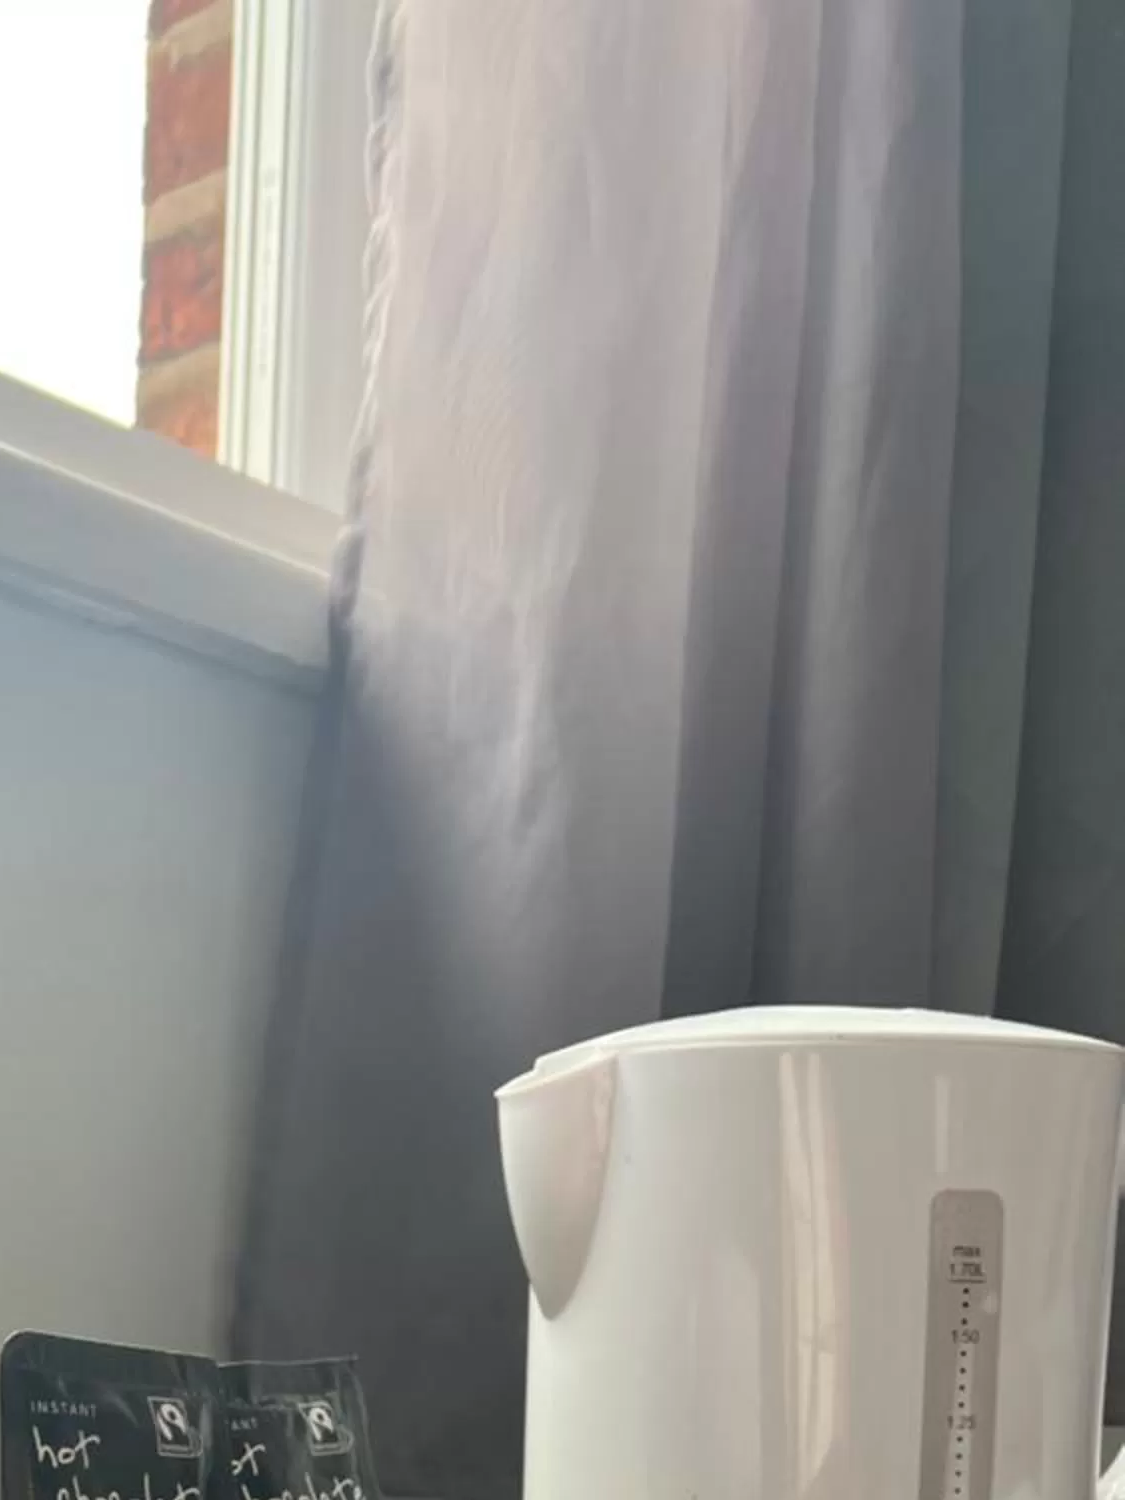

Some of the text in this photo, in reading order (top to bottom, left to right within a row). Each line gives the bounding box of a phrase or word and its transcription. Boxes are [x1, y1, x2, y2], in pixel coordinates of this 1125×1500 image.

[30, 1401, 97, 1418] INSTANT
[32, 1424, 101, 1469] hot
[231, 1443, 266, 1477] ot
